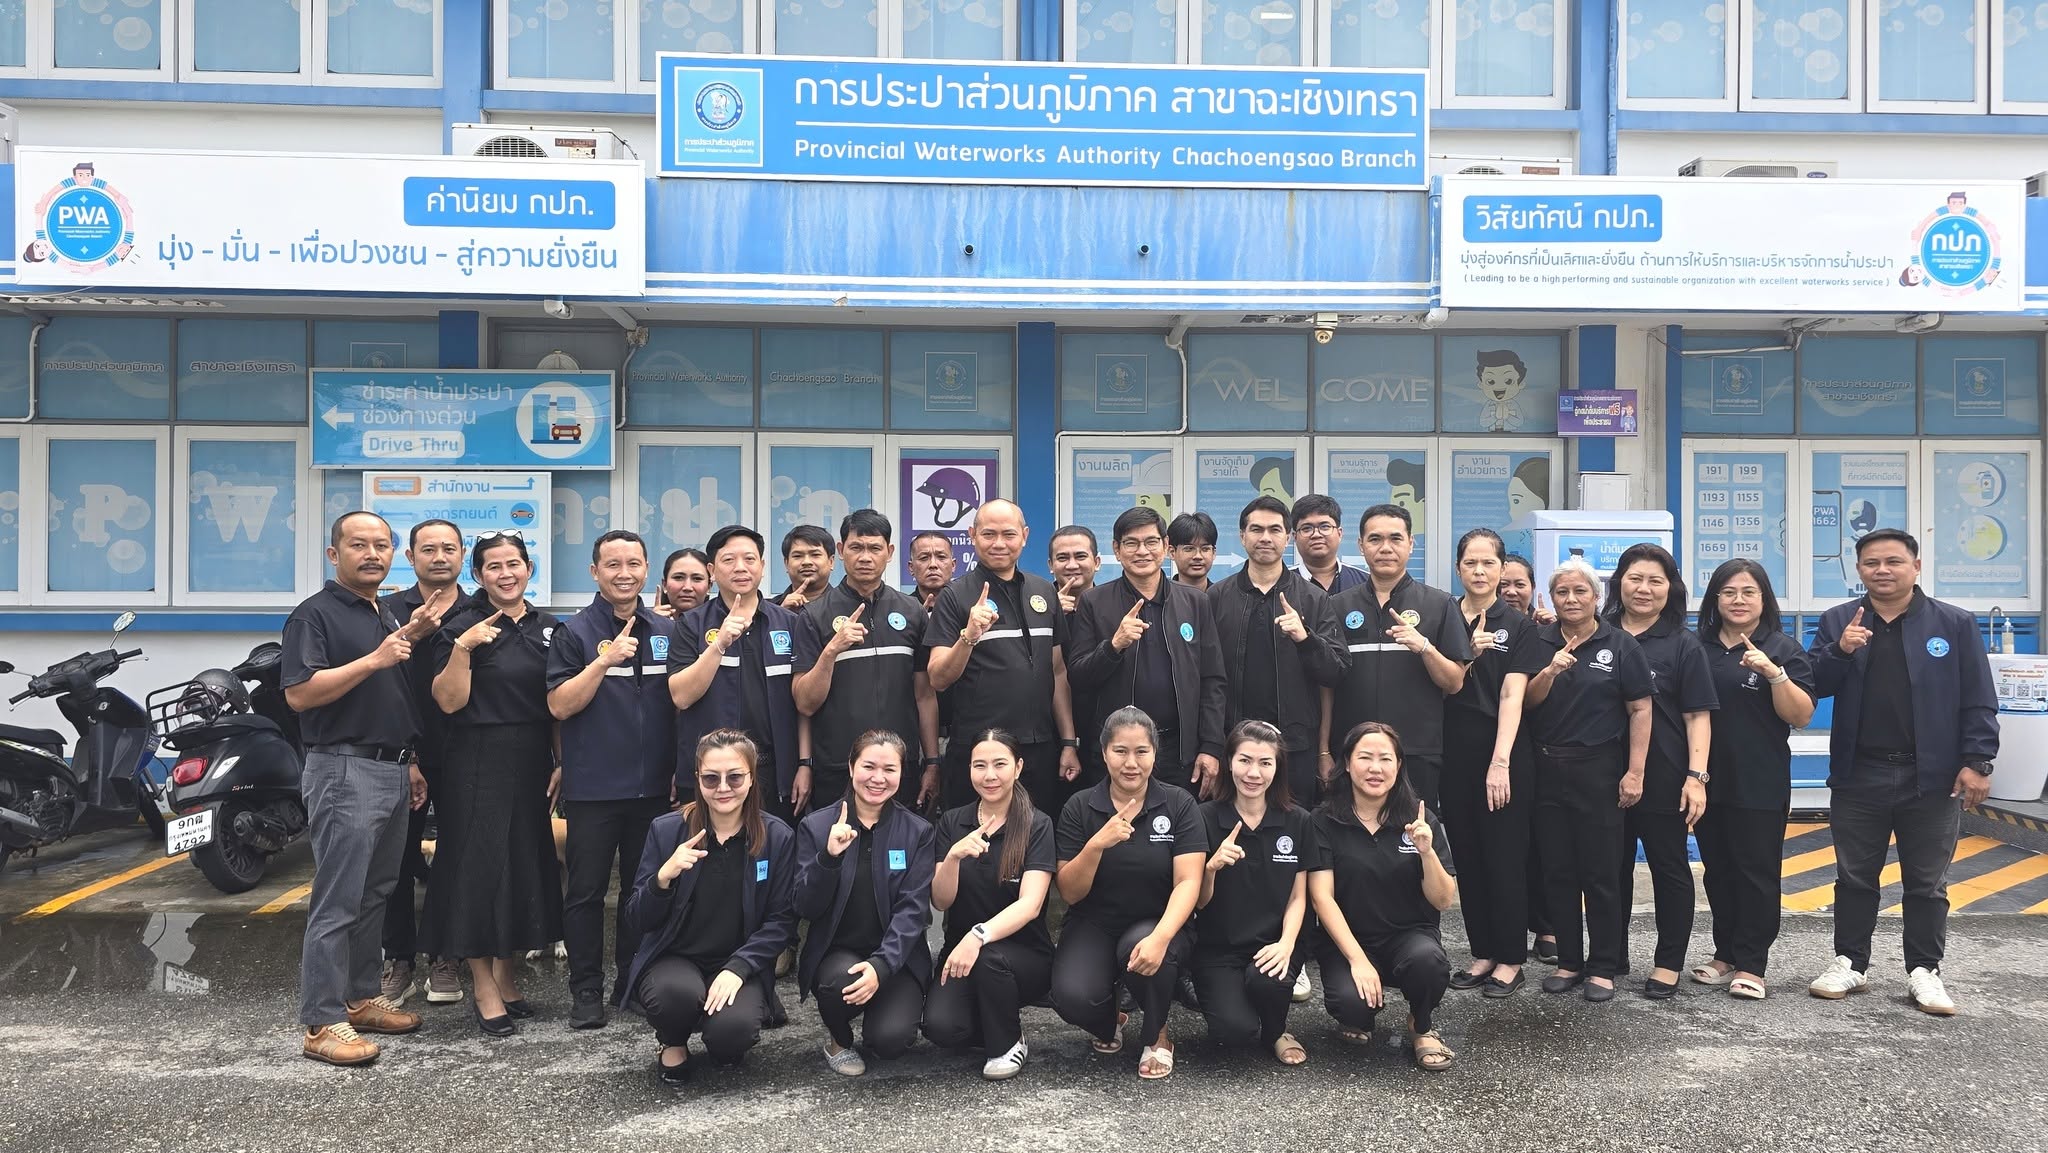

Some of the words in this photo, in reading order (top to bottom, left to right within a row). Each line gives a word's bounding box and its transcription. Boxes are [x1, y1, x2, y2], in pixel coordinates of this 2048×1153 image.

[795, 71, 1158, 123] การประปาส่วนภูมิภาค
[1171, 79, 1417, 118] สาขาฉะเชิงเทรา
[795, 139, 904, 160] Provincial
[915, 142, 1047, 163] Waterworks
[1057, 144, 1161, 170] Authority
[1172, 147, 1334, 173] Chachoengsao
[1341, 149, 1417, 169] Branch
[426, 184, 517, 215] ค่านิยม
[528, 190, 594, 217] กปภ.
[59, 205, 109, 225] PWA
[1476, 200, 1583, 230] วิสัยทัศน์
[1594, 204, 1655, 229] กปภ.
[1932, 230, 1981, 251] กปภ
[158, 236, 193, 276] มุ่ง
[222, 231, 260, 263] มั่น
[290, 230, 427, 267] เพื่อปวงชน
[456, 238, 617, 277] สู่ความยั่งยืน
[1461, 248, 1635, 269] มุ่งสู่องค์กรที่เป็นเลิศและยั่งยืน
[1640, 250, 1894, 269] ด้านการให้บริการและบริหารจัดการน้ำประปา
[1470, 274, 1504, 284] Leading
[1507, 274, 1517, 283] to
[1519, 274, 1530, 283] be
[1542, 274, 1560, 285] high
[1562, 275, 1610, 285] performing
[1613, 276, 1629, 284] and
[1632, 276, 1679, 285] sustainable
[1682, 277, 1736, 286] organization
[1739, 277, 1756, 285] with
[1760, 277, 1799, 286] excellent
[1802, 278, 1850, 286] waterworks
[1853, 279, 1884, 287] service
[45, 360, 163, 374] การประปาส่วนภูมิภาค
[190, 361, 296, 373] สาขาฉะเชิงเทรา
[632, 371, 667, 381] Provincial
[670, 372, 712, 382] Waterworks
[716, 372, 748, 385] Authority
[769, 371, 837, 384] Chachoengsao
[844, 373, 879, 384] Branch
[362, 375, 513, 400] ชำระค่าน้ำประปา
[1211, 377, 1288, 401] WEL
[1320, 378, 1428, 402] COME
[362, 403, 477, 425] ช่องทางด่วน
[369, 437, 413, 451] Drive
[420, 438, 459, 451] Thru
[1079, 458, 1130, 472] งานผลิต
[1204, 456, 1249, 467] งานจัดเก็บ
[1472, 457, 1490, 465] งาน
[1213, 466, 1239, 477] รายได้
[1458, 465, 1507, 476] อำนวยการ
[1706, 466, 1722, 475] 191
[1739, 466, 1757, 475] 199
[428, 480, 490, 493] สำนักงาน
[1702, 493, 1725, 502] 1193
[1737, 493, 1759, 502] 1155
[424, 506, 498, 520] จอดรถยนต์
[1814, 507, 1835, 516] PWA
[1702, 519, 1724, 528] 1146
[1735, 517, 1760, 526] 1356
[1813, 516, 1836, 526] 1662
[1700, 543, 1726, 552] 1669
[1736, 543, 1758, 552] 1154
[174, 835, 206, 851] 4792
